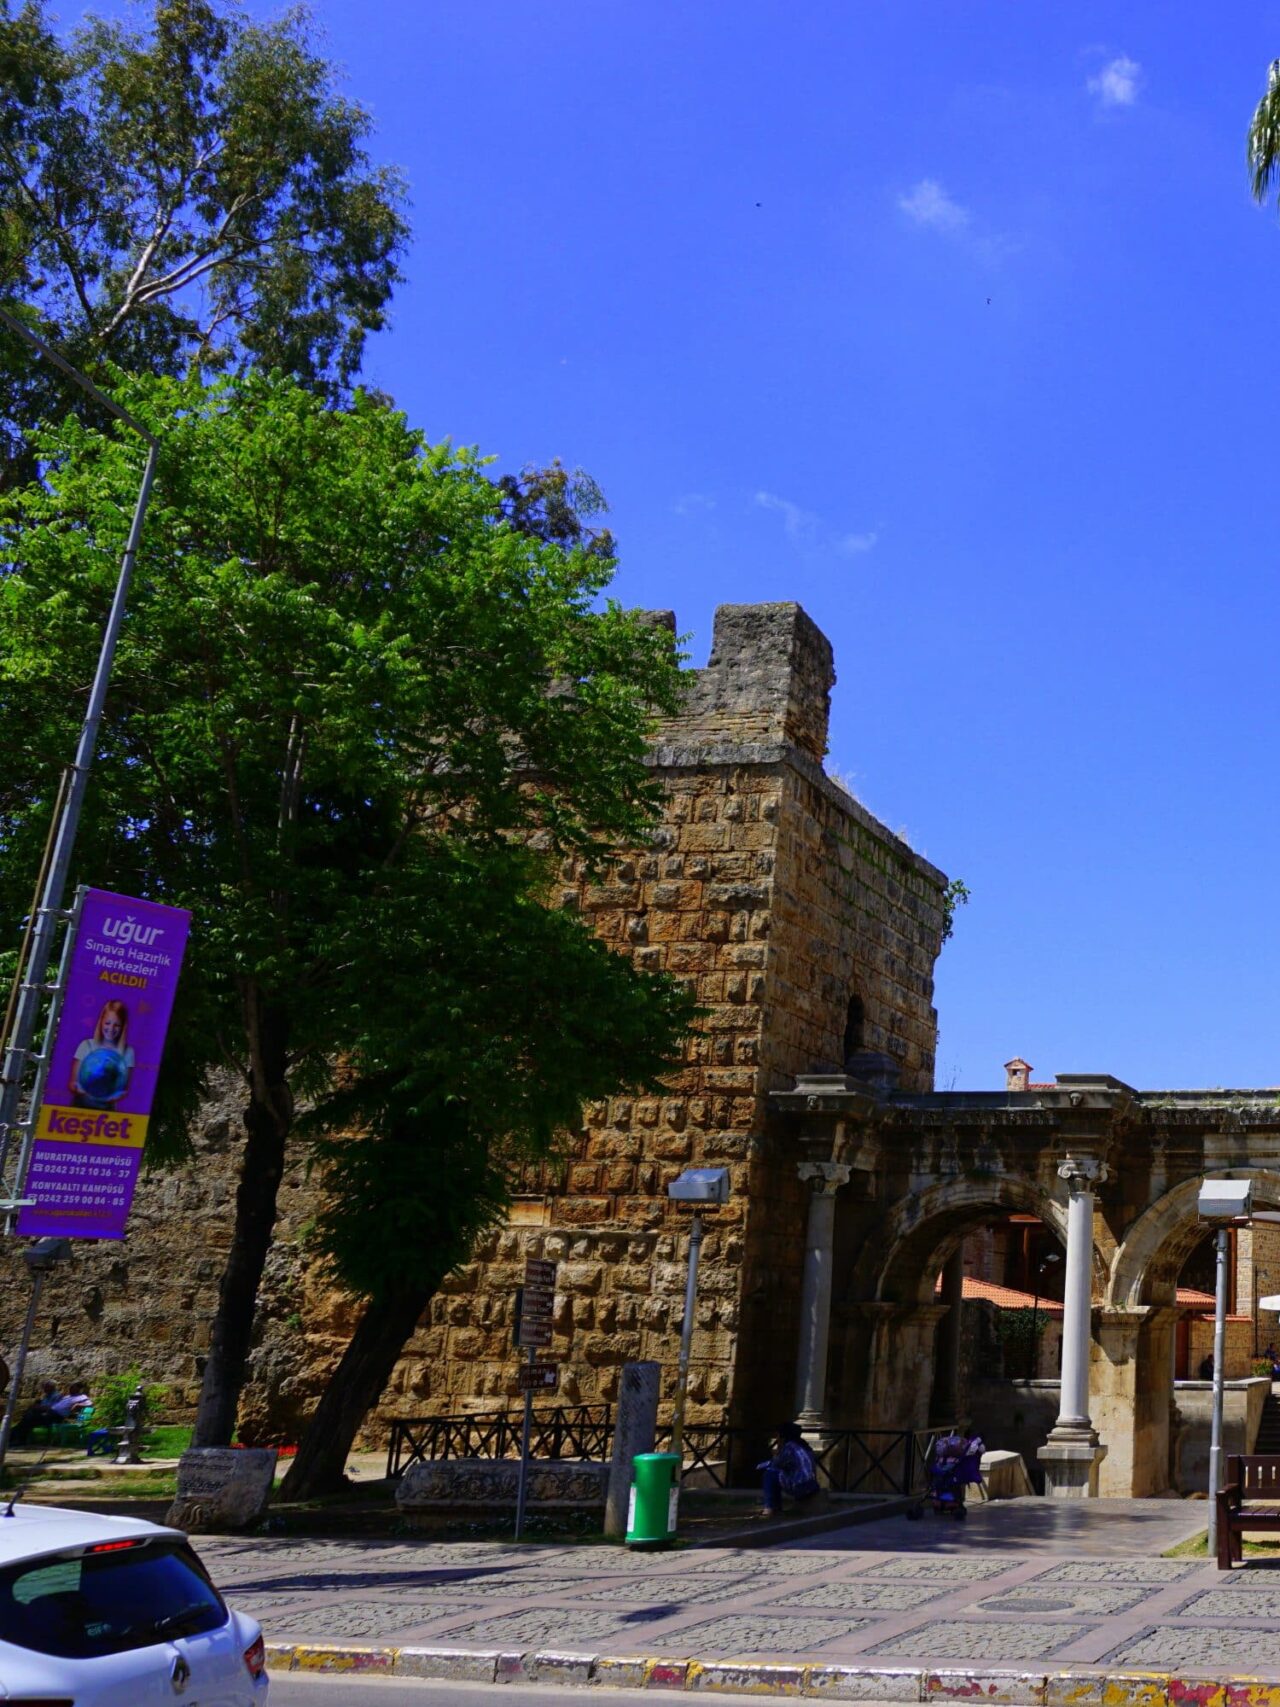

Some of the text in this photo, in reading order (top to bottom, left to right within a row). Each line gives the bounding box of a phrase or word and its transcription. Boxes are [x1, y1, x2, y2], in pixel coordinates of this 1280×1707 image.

[102, 915, 164, 945] uğur
[85, 938, 171, 967] Sınava Hazırlık
[94, 954, 158, 977] Merkezleri
[47, 1109, 133, 1142] keşfet
[35, 1151, 133, 1167] MURATPAŞA KAMPÜSÜ
[44, 1164, 68, 1174] 0242
[69, 1166, 86, 1176] 312
[88, 1168, 99, 1176] 10
[118, 1170, 130, 1178] 37
[31, 1181, 125, 1194] KONYAALTI KAMPÜSÜ
[38, 1193, 61, 1203] 0242
[62, 1195, 80, 1203] 259
[81, 1196, 92, 1205] 00
